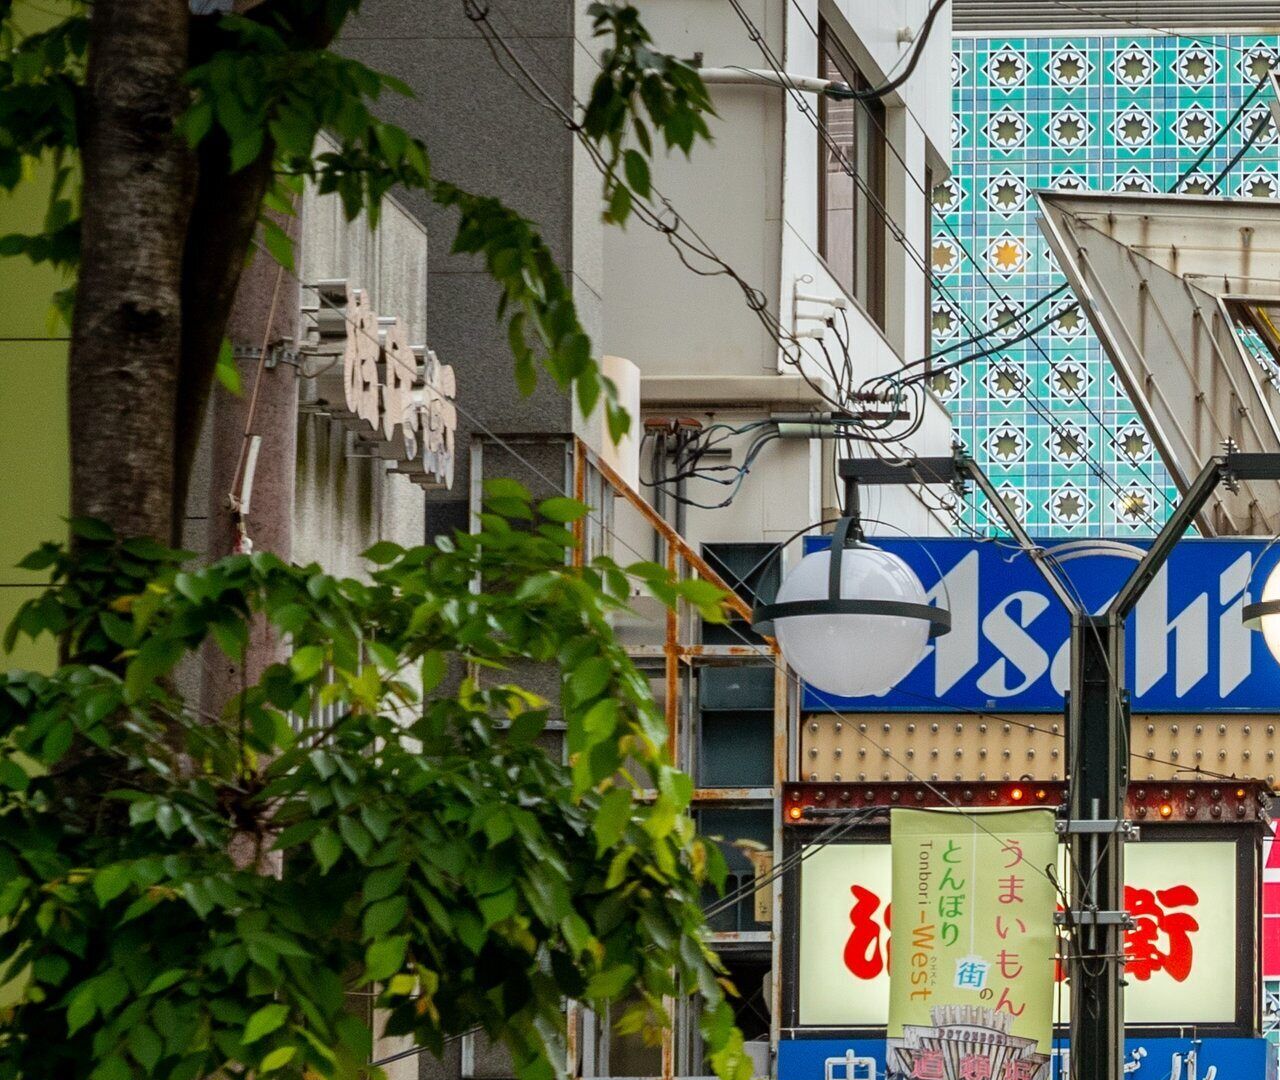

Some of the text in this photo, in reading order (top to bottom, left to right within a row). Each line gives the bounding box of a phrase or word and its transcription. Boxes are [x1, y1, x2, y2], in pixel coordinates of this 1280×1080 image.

[917, 840, 934, 906] Tonbori
[938, 839, 966, 948] とんぼり
[994, 838, 1027, 1017] うまいもん
[979, 987, 994, 1001] の
